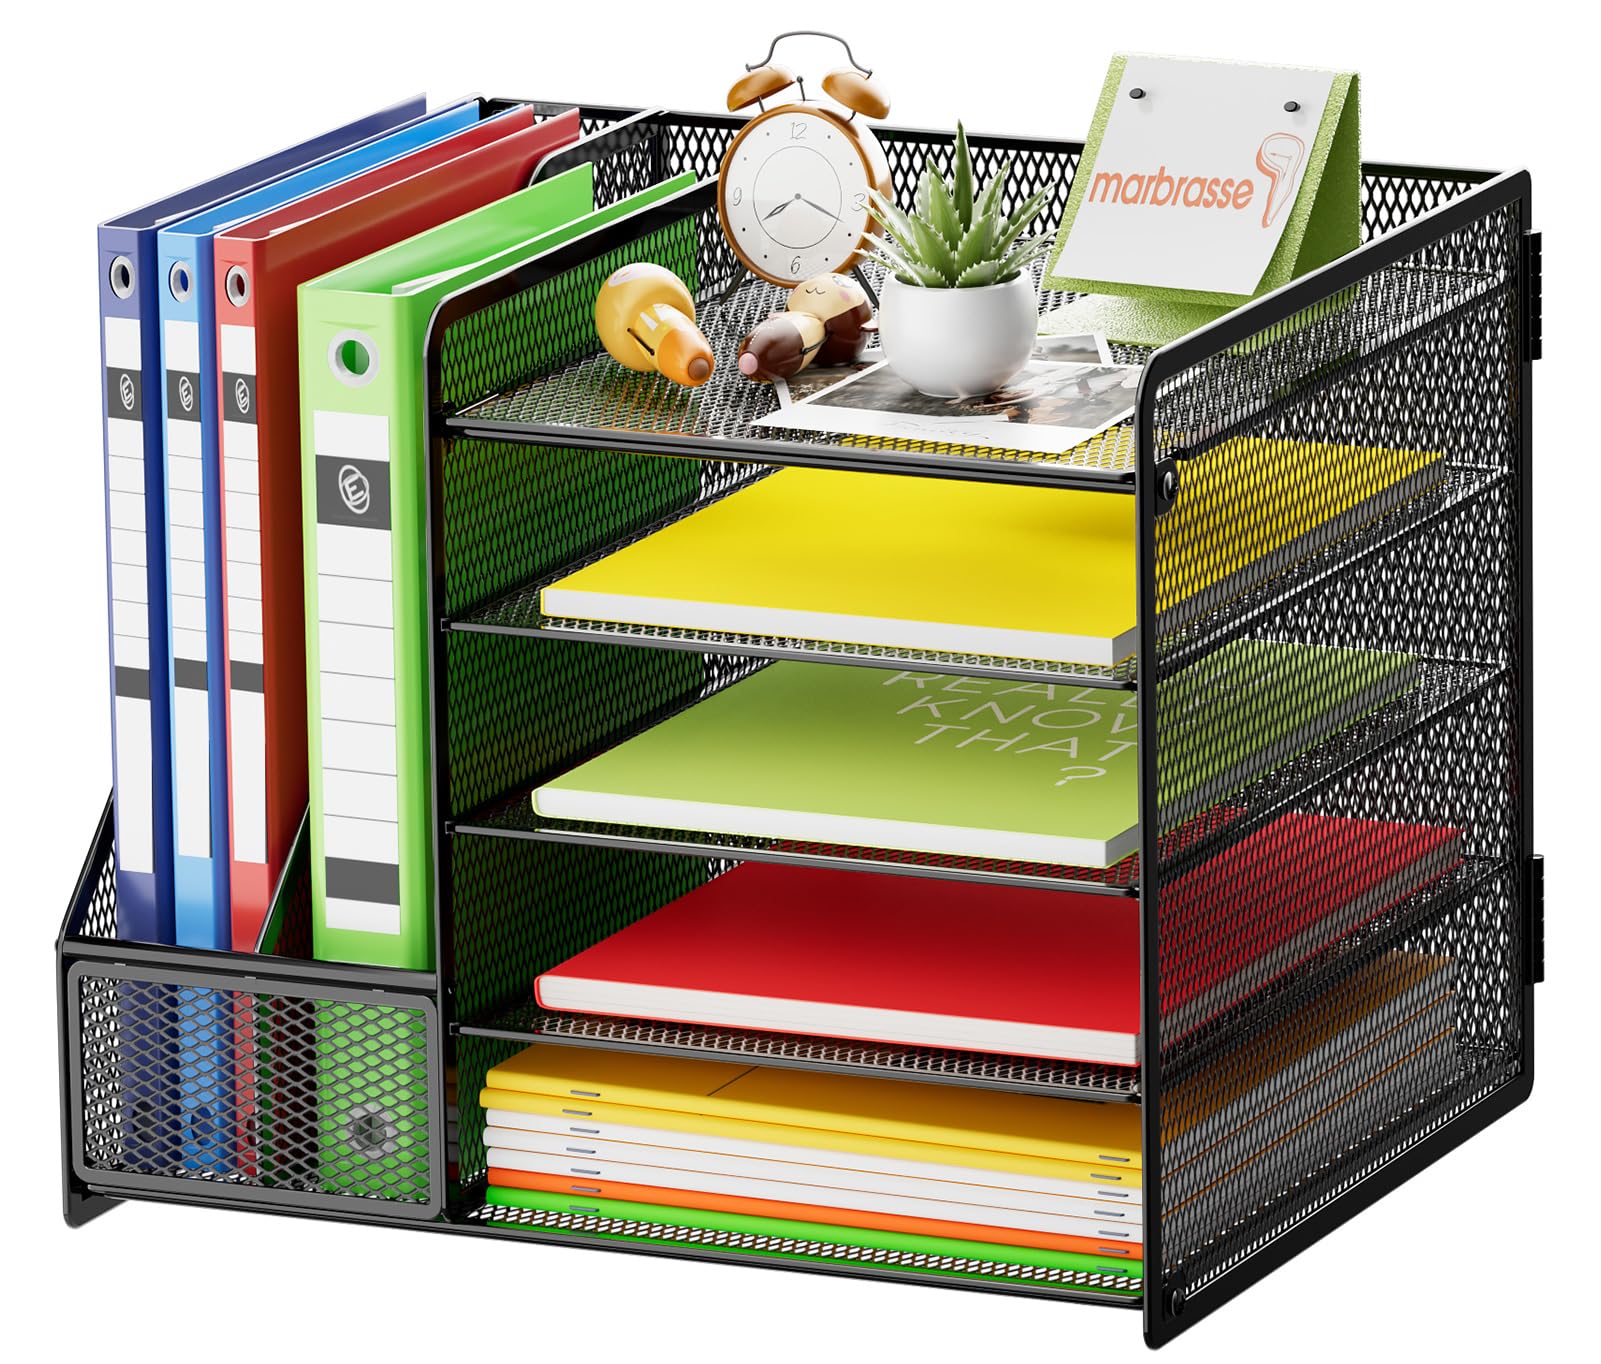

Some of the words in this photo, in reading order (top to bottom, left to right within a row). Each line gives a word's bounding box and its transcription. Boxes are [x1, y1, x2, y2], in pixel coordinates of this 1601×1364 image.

[790, 121, 808, 140] 12
[732, 186, 743, 207] 9
[1088, 166, 1255, 210] marbrasse
[848, 193, 867, 212] 3
[790, 255, 801, 275] 6
[1055, 765, 1107, 786] ?
